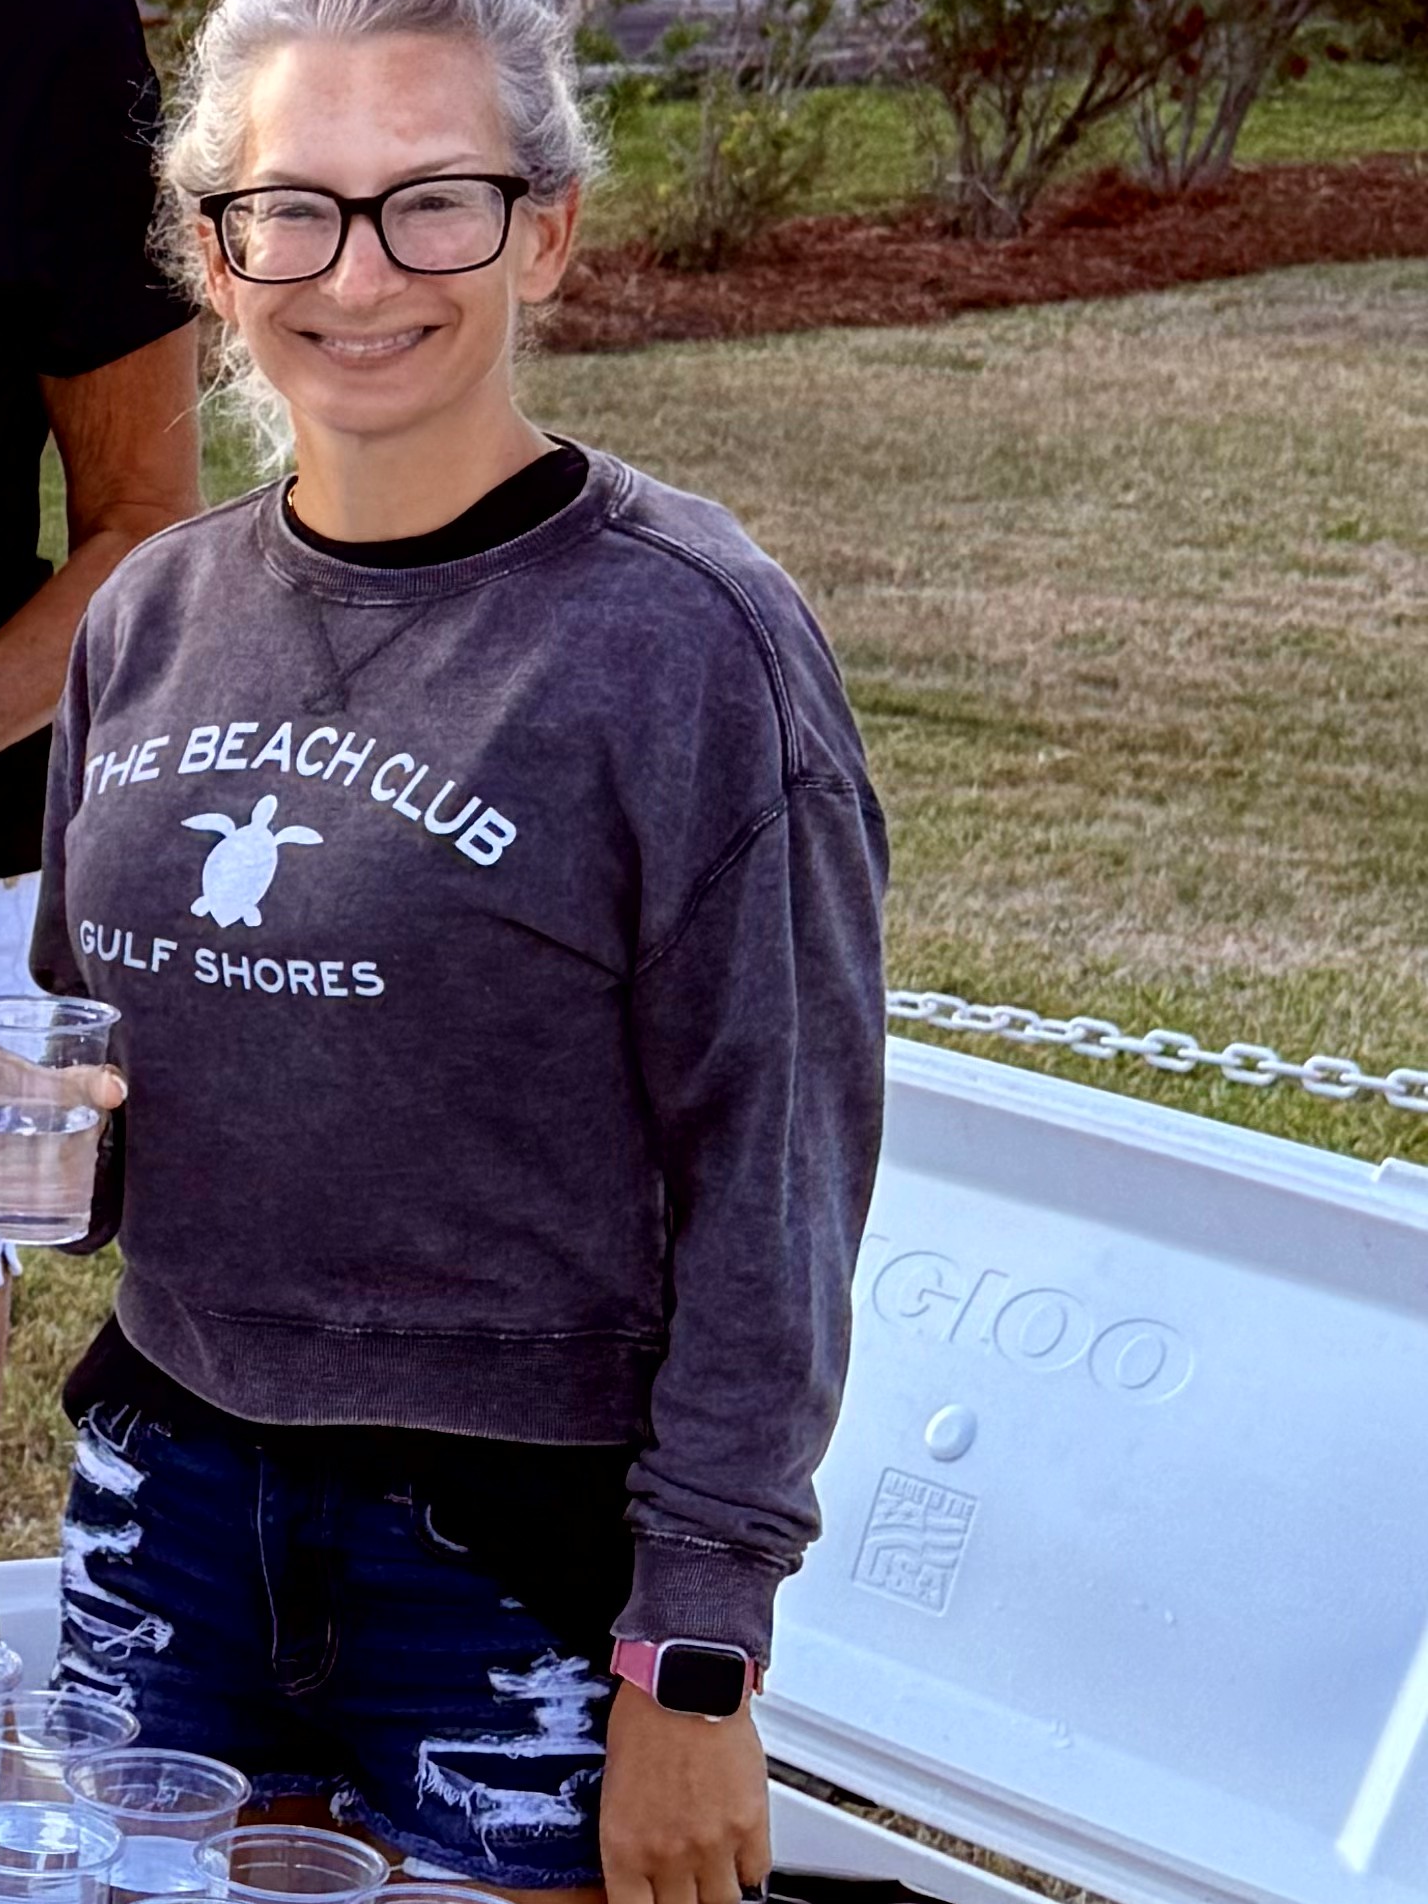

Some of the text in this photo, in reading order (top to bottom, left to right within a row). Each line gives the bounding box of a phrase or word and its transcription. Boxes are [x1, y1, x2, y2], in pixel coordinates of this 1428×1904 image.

[83, 721, 518, 867] THE BEACH CLUB
[79, 919, 386, 998] GULF SHORES
